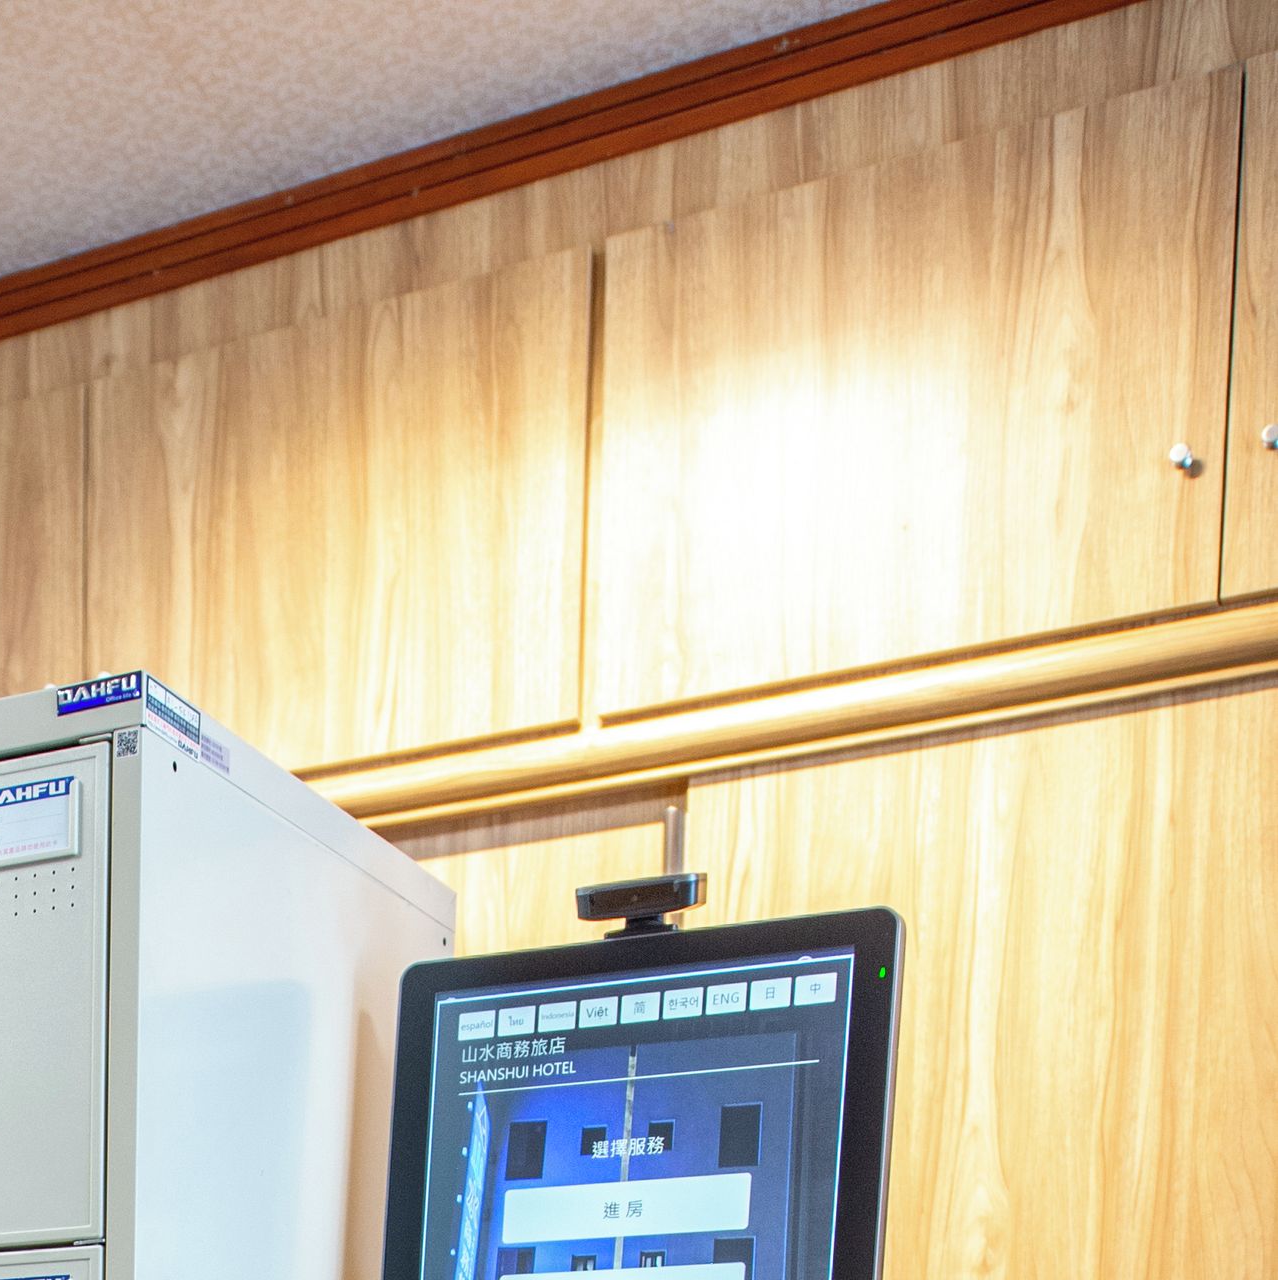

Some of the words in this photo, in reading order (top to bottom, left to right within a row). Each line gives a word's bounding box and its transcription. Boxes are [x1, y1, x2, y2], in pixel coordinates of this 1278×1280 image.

[461, 1019, 493, 1031] español
[508, 1016, 524, 1026] ไทย
[586, 1006, 608, 1019] Việt
[669, 996, 698, 1010] 한국어
[713, 992, 740, 1005] ENG
[765, 987, 775, 999] 日
[810, 983, 821, 994] 中
[462, 1037, 566, 1063] 山水商務旅店
[459, 1064, 529, 1084] SHANSHUI
[533, 1061, 576, 1077] HOTEL
[592, 1136, 665, 1159] 選擇服務
